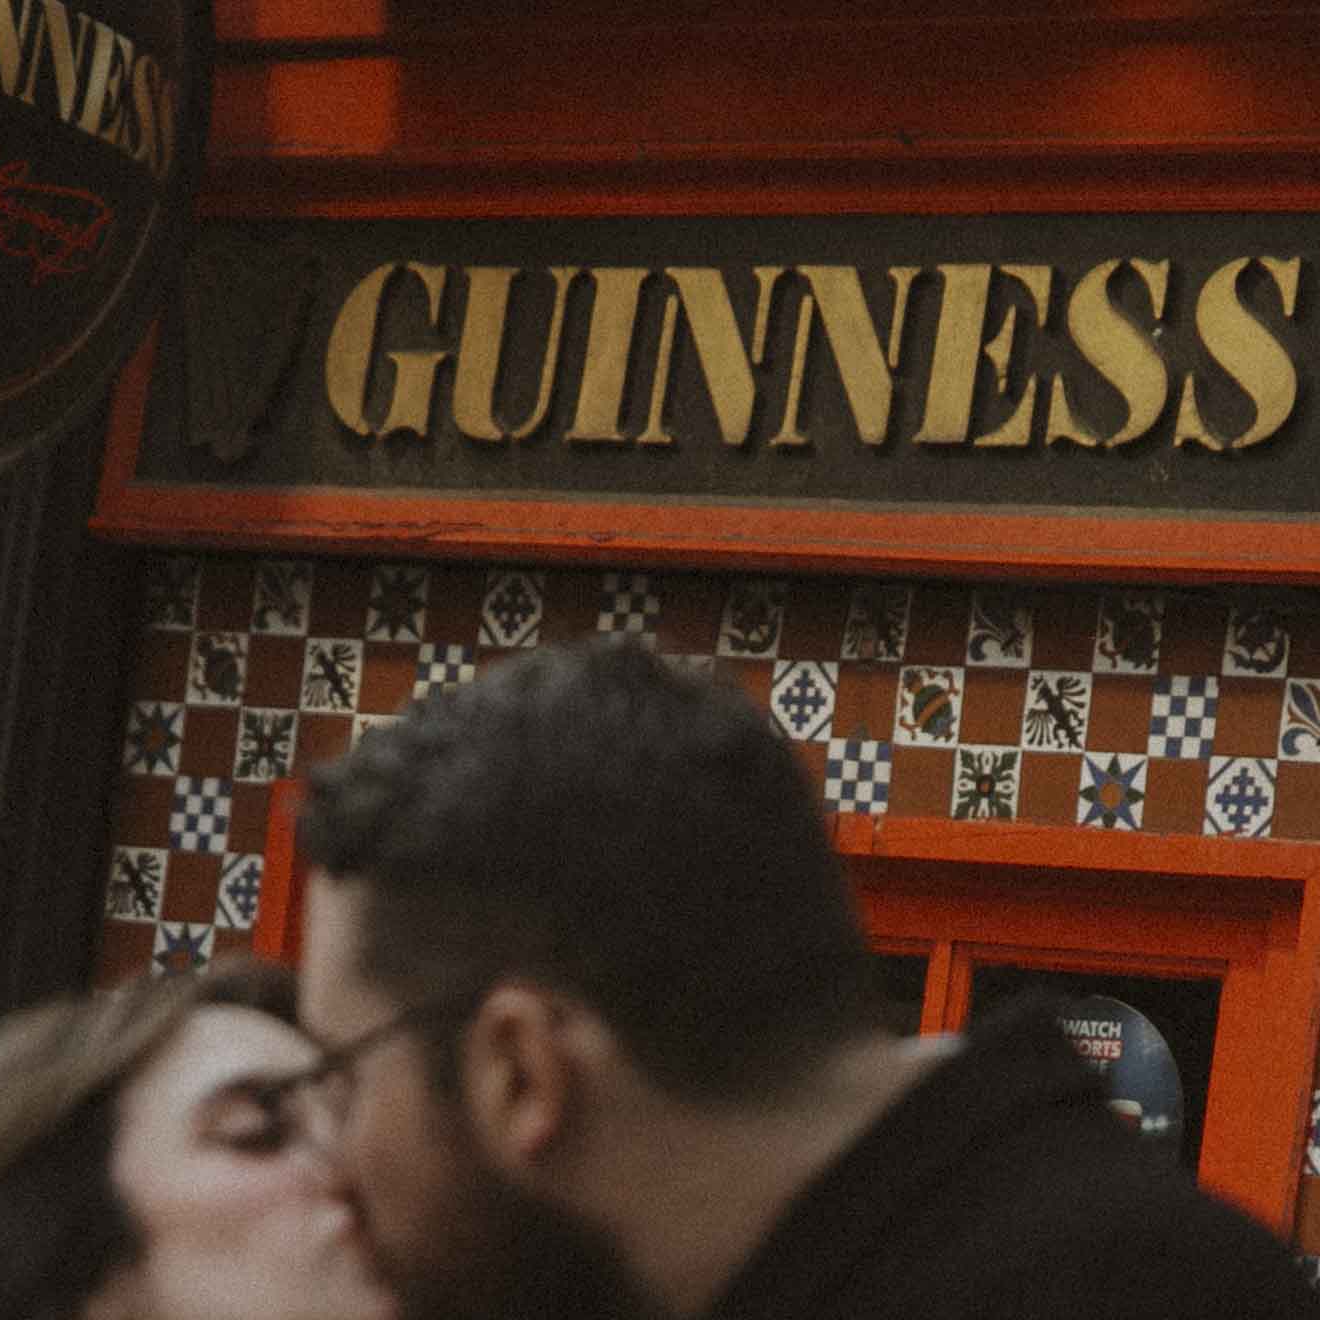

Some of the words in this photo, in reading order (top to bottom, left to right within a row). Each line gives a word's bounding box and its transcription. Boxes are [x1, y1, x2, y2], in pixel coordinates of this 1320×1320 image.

[323, 256, 1302, 451] GUINNESS
[1062, 1019, 1122, 1038] WATCH
[1072, 1039, 1122, 1058] ORTS
